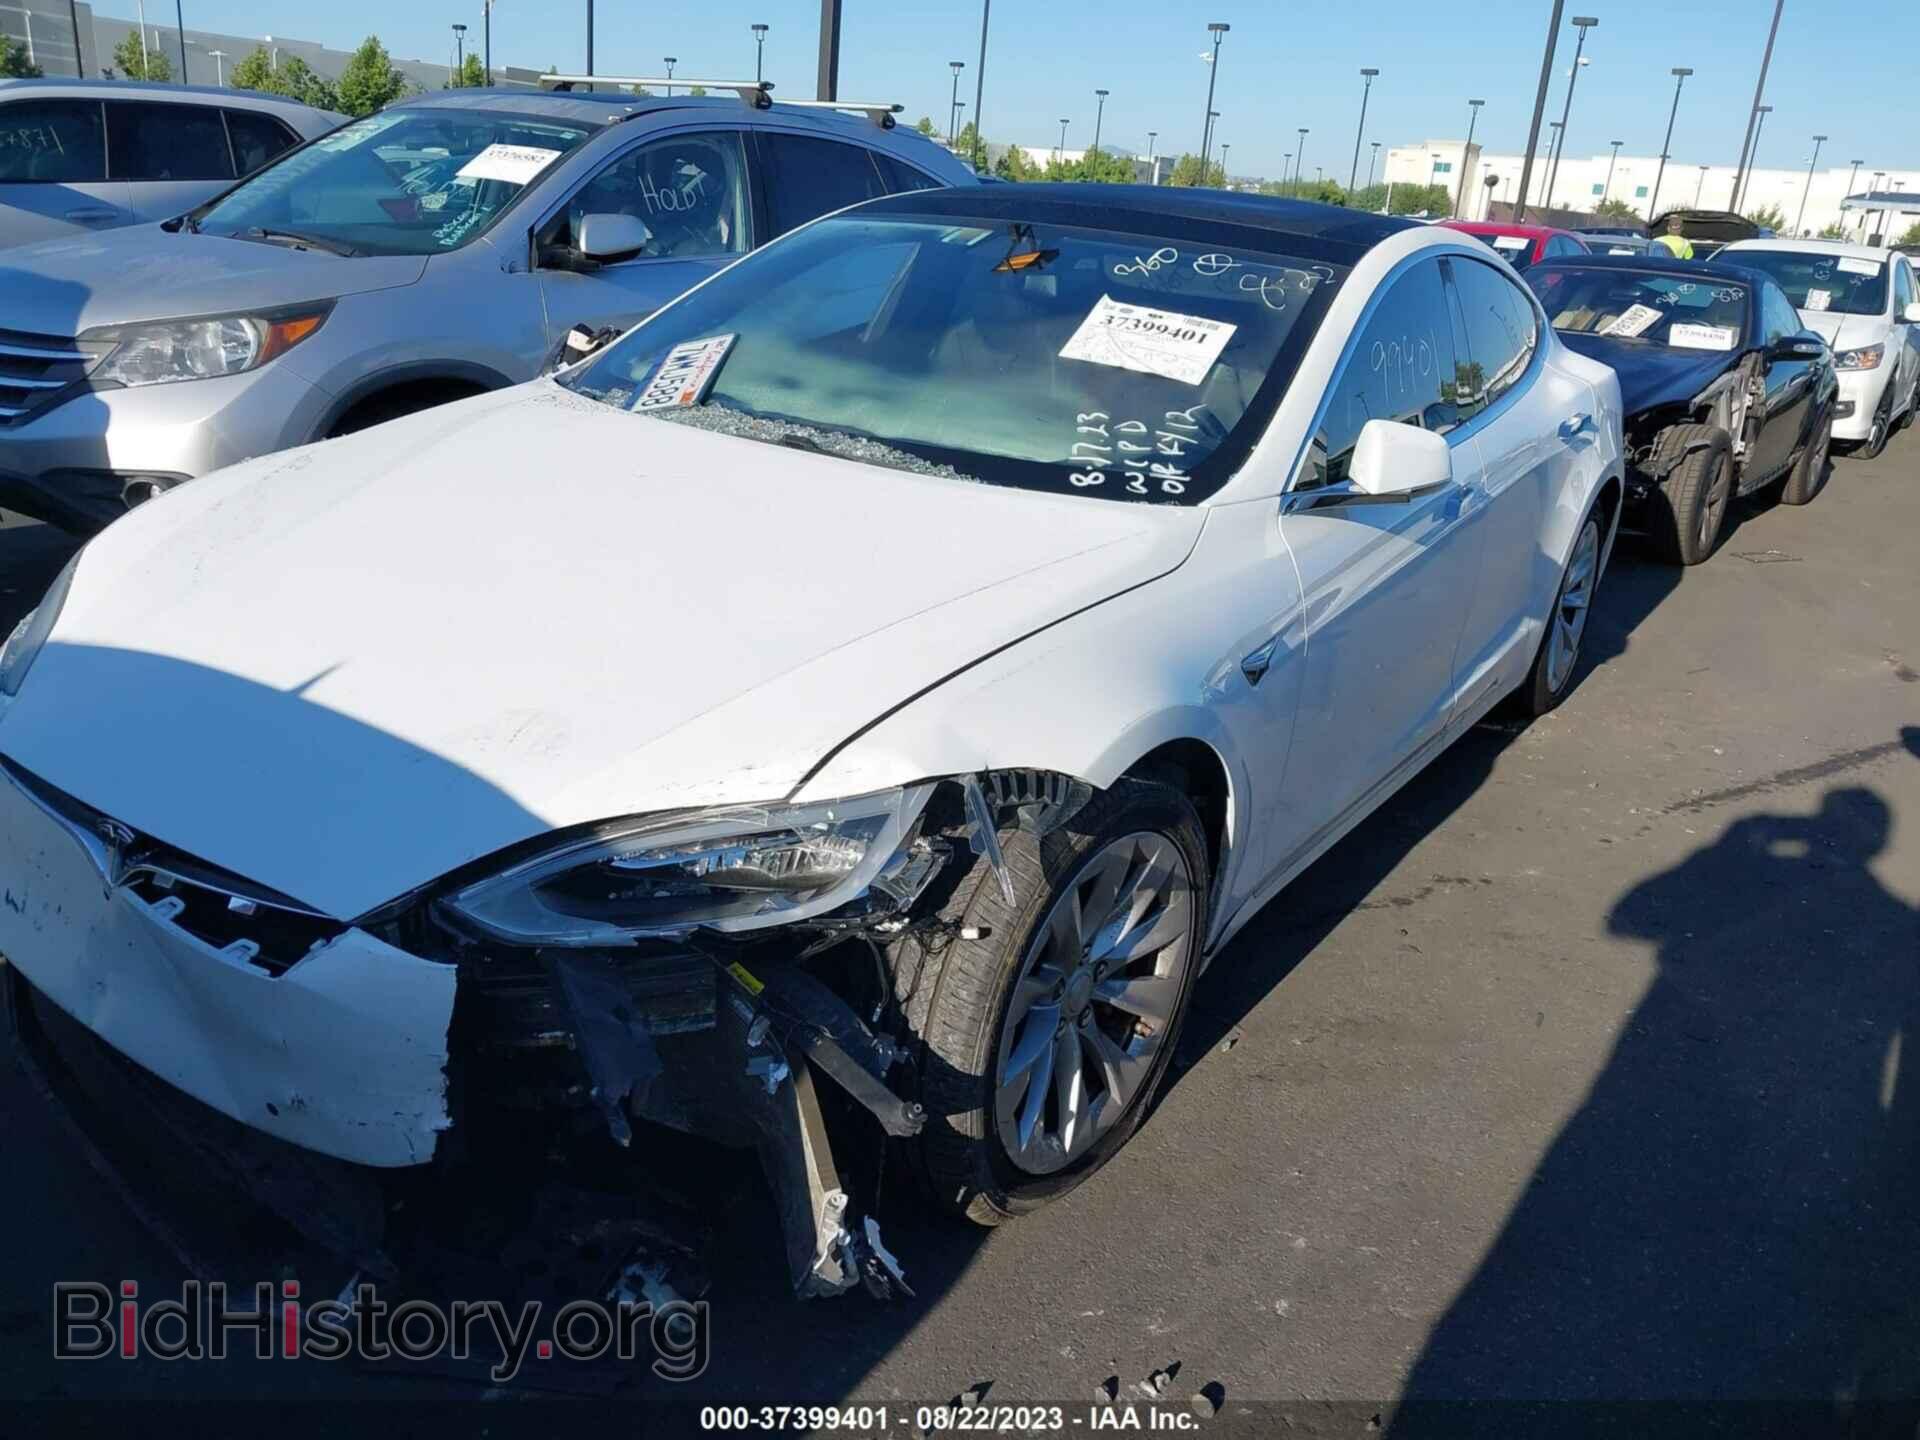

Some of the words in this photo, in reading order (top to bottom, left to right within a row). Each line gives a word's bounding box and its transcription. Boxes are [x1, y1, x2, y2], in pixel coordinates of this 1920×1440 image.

[638, 173, 698, 215] HOLD
[1100, 314, 1208, 344] 37399401
[1370, 327, 1441, 404] 99401
